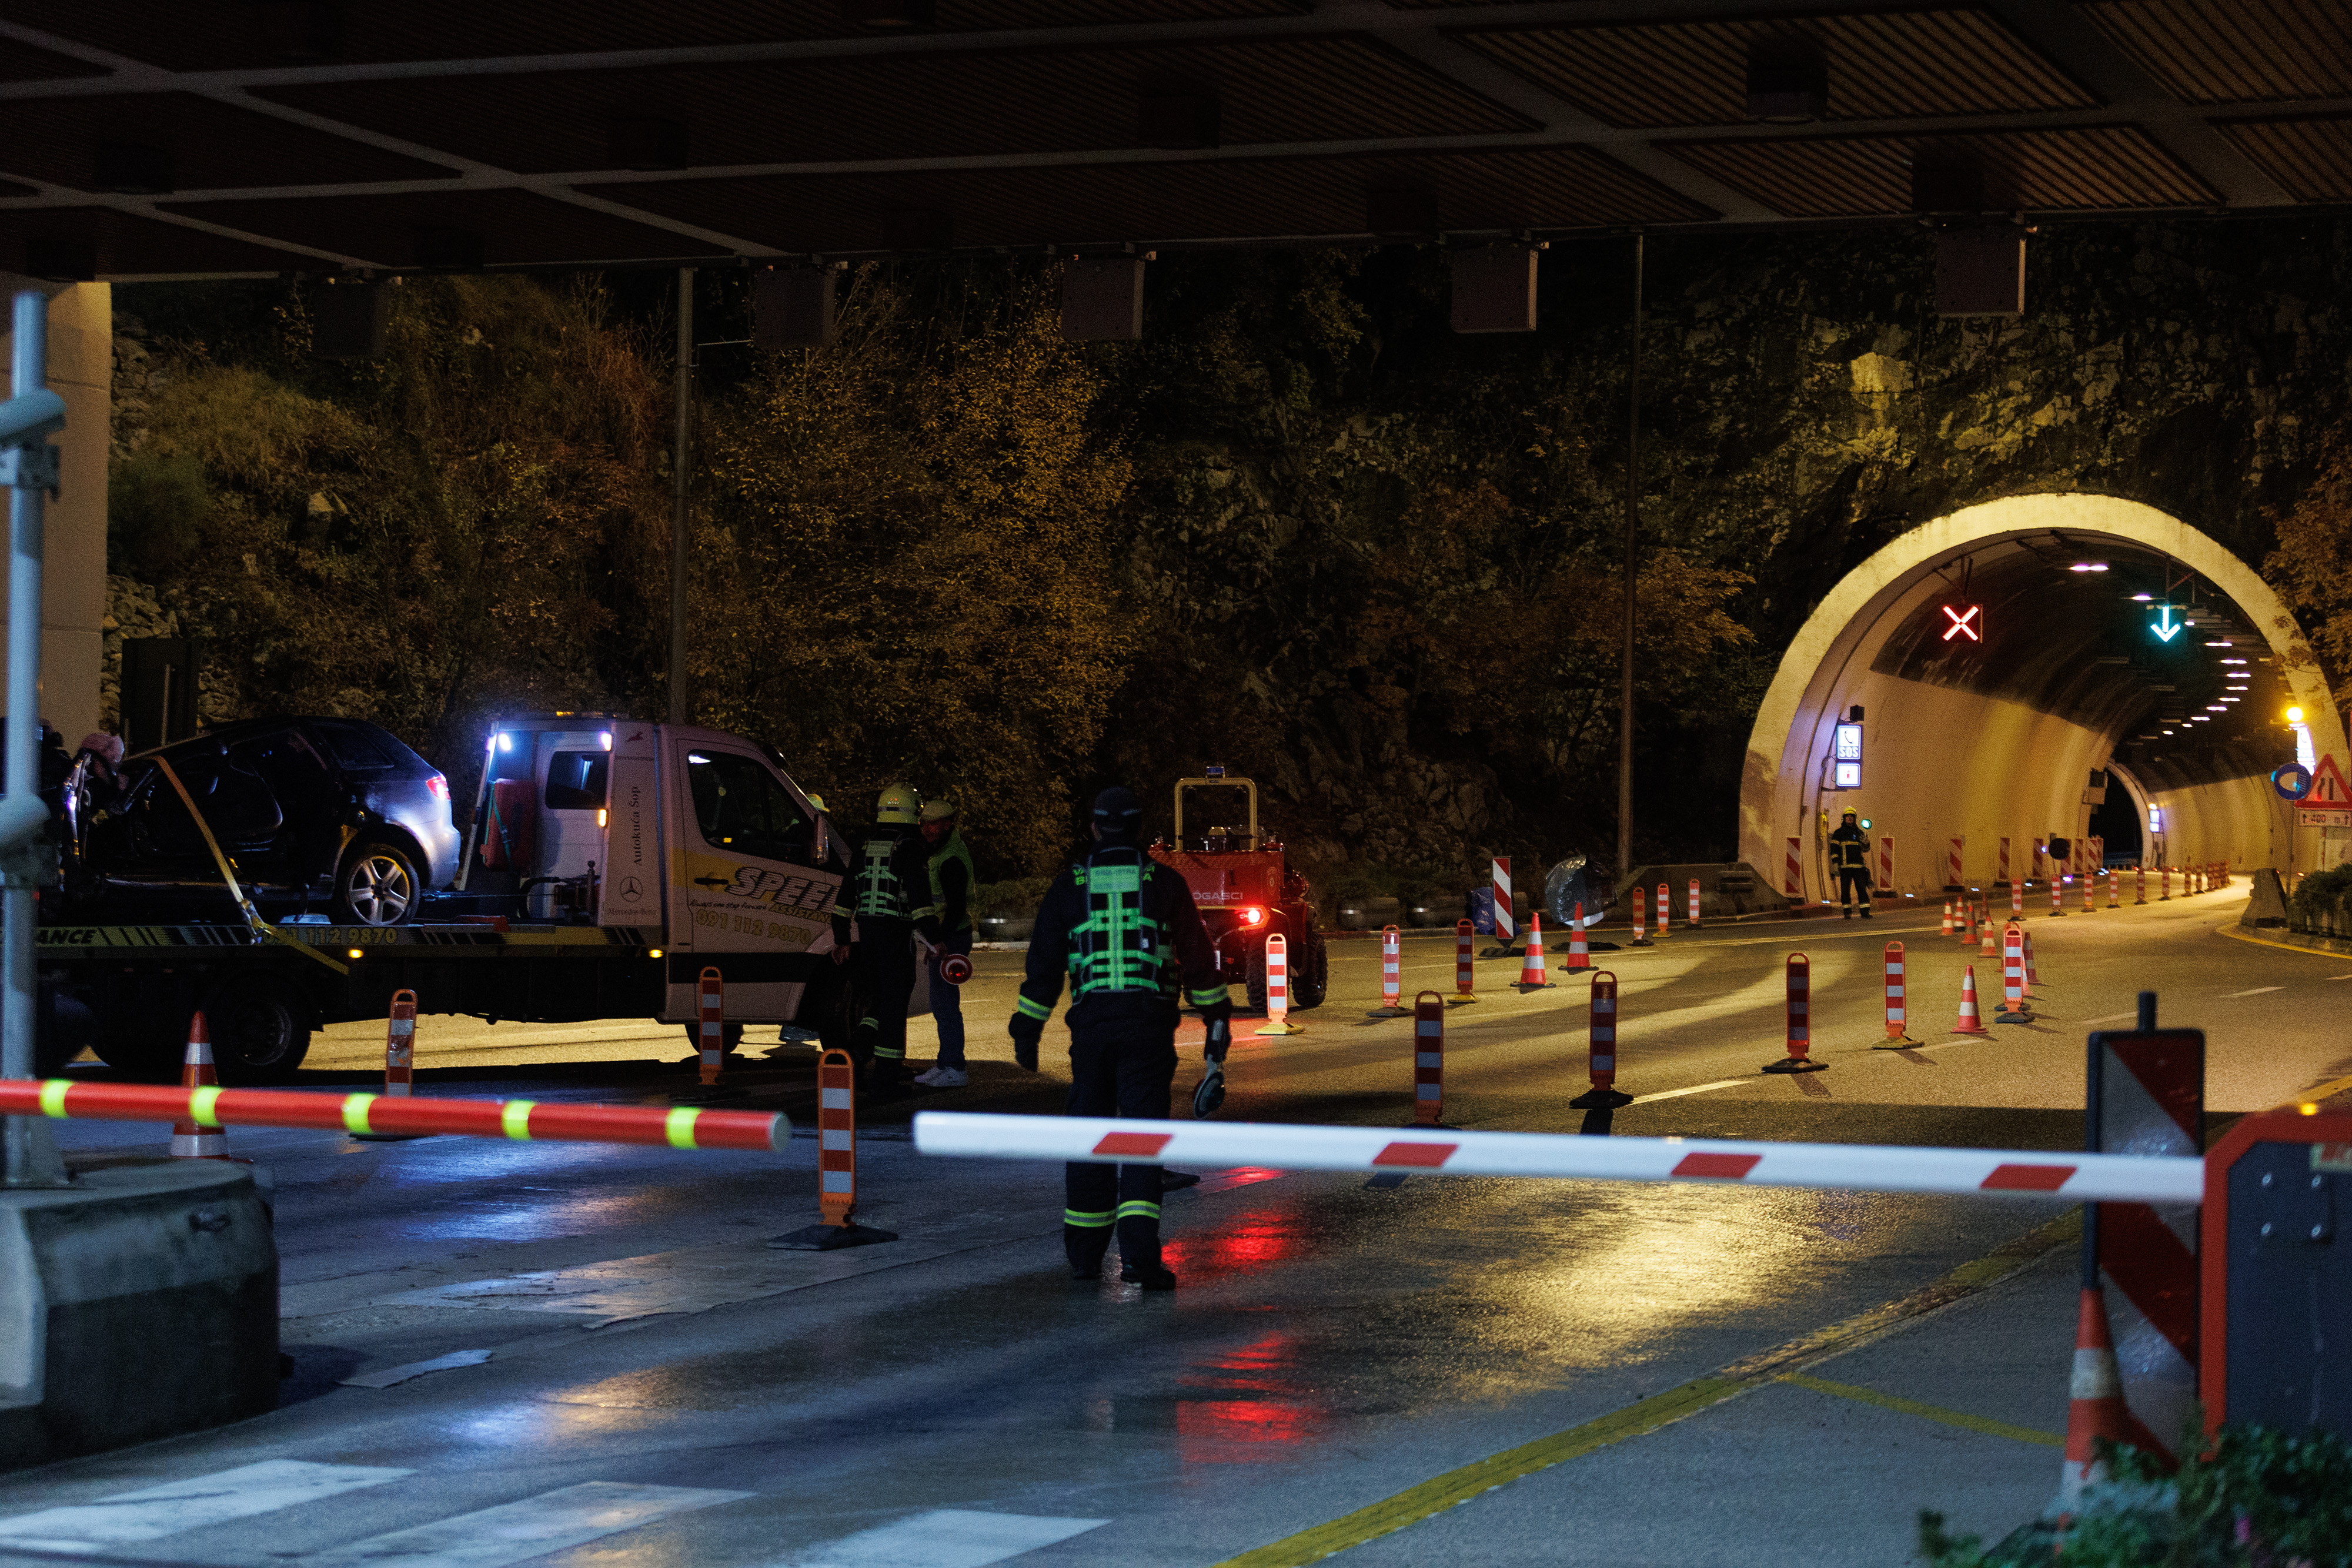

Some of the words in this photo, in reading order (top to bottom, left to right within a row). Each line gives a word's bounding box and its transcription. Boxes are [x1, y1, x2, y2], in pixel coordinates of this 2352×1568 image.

[1839, 746, 1859, 758] SOS
[629, 786, 641, 808] Šop
[630, 811, 642, 867] Autokuća
[1192, 892, 1244, 900] OGASCI
[307, 927, 342, 944] 112
[348, 927, 397, 944] 9870
[696, 909, 728, 929] 091
[734, 915, 764, 936] 112
[768, 922, 811, 945] 9870
[36, 929, 98, 944] ANCE
